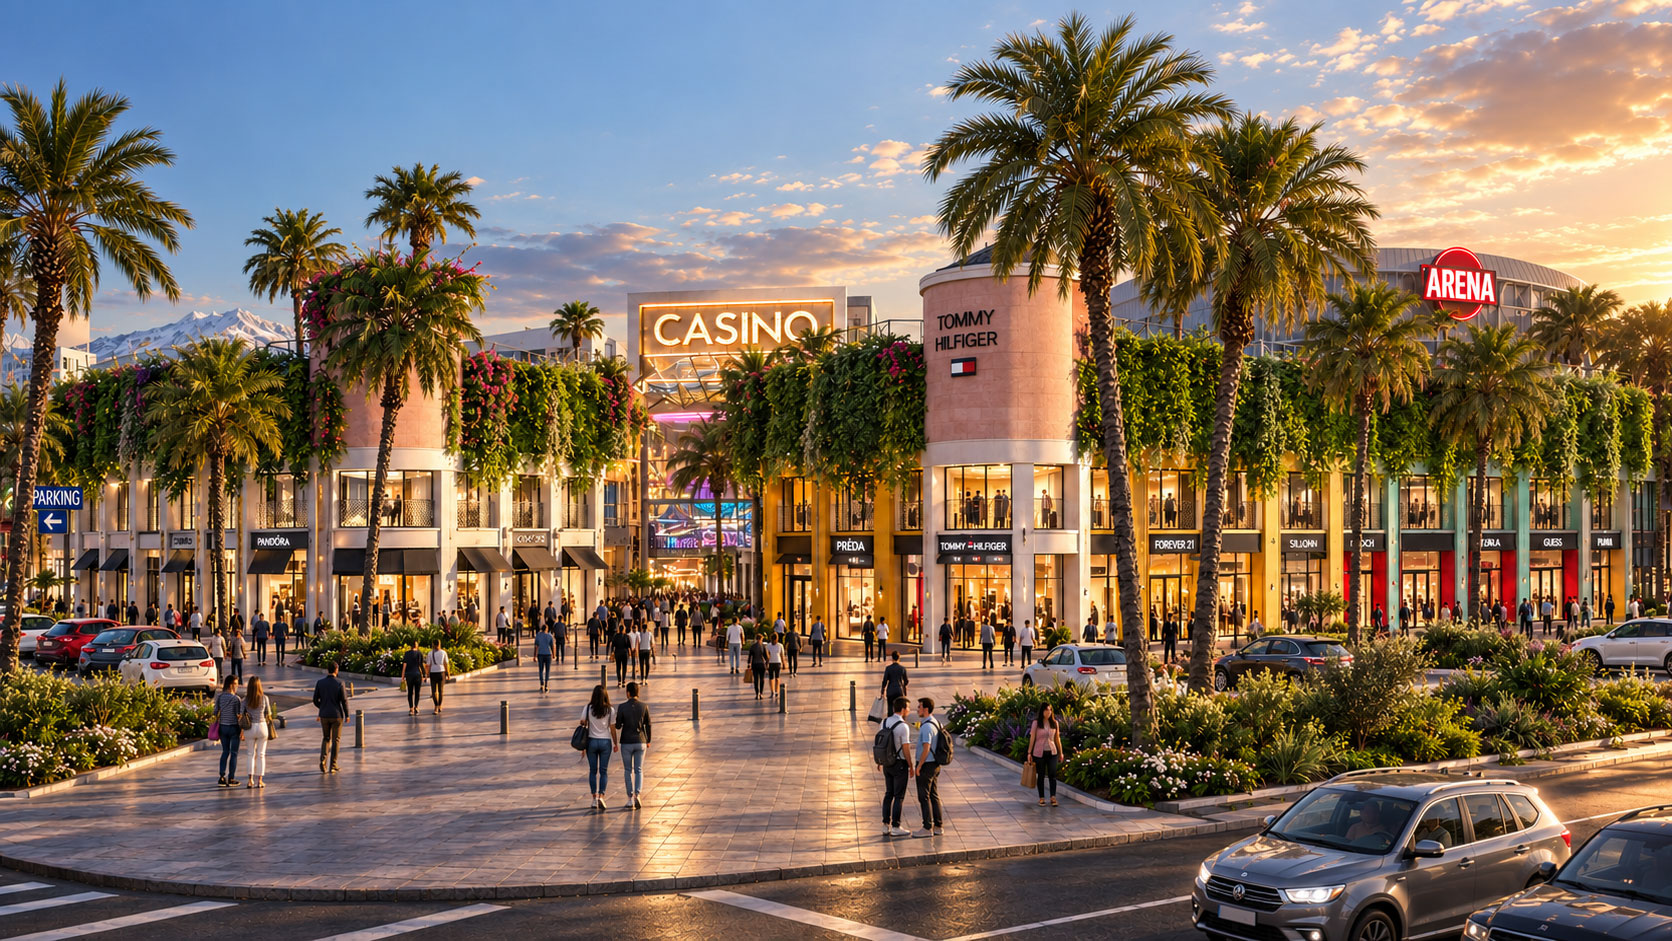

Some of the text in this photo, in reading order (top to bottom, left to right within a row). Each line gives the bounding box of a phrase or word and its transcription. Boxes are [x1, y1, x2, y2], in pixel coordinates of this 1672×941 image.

[1426, 268, 1495, 302] ARENA
[653, 310, 818, 346] CASINO
[937, 309, 995, 331] TOMMY
[935, 331, 998, 352] HILFIGER
[32, 489, 80, 506] PARKING
[940, 541, 967, 551] TOMMY
[1154, 539, 1195, 550] FOREVER 21
